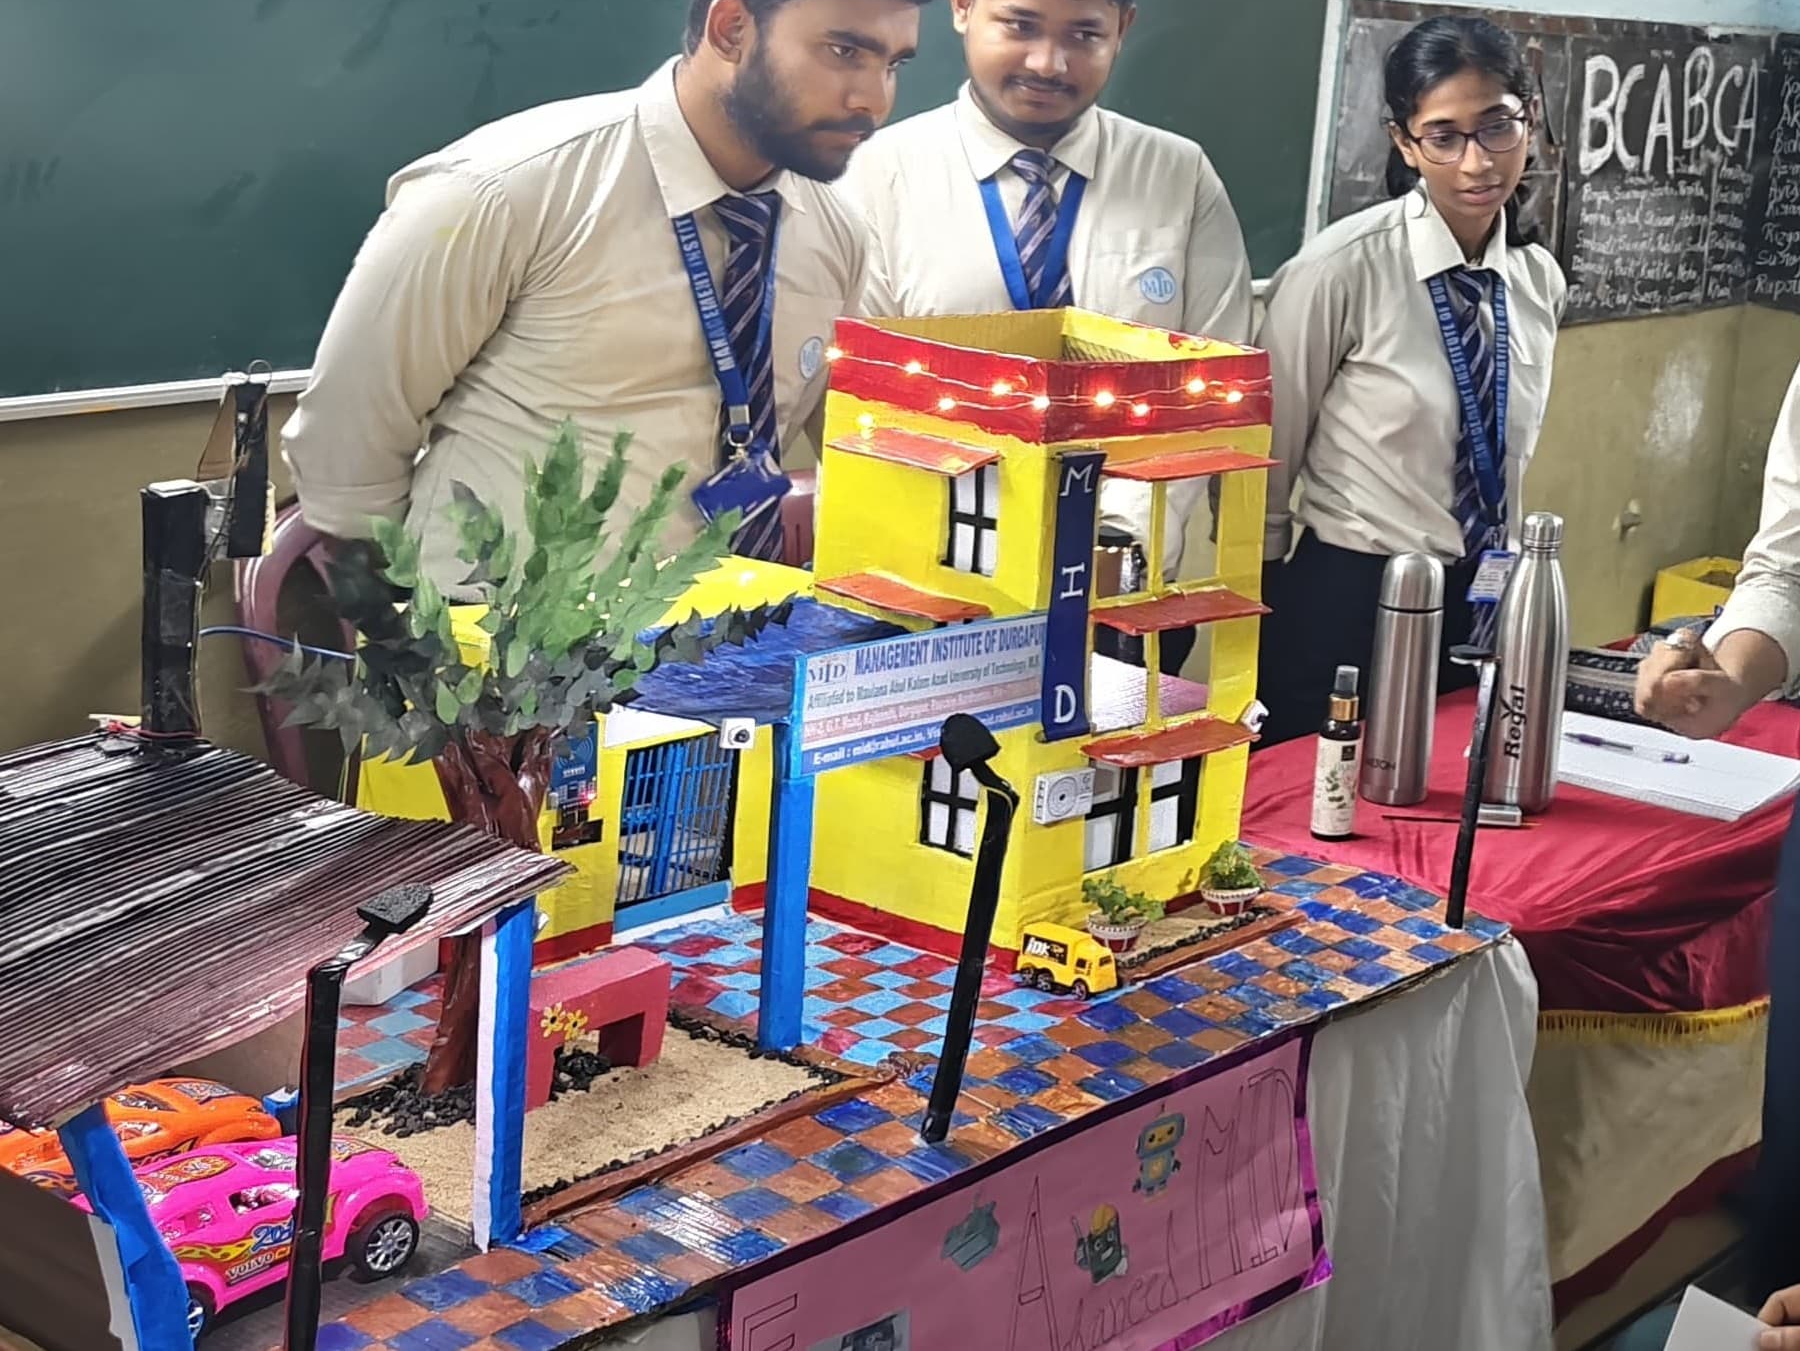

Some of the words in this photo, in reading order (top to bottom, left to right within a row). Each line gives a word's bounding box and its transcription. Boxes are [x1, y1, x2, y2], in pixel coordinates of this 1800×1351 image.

[1579, 53, 1676, 177] BCA
[1682, 46, 1758, 169] BCA
[675, 218, 705, 268] INSTIT
[854, 638, 931, 676] MANAGEMENT
[931, 631, 983, 663] INSTITUTE
[984, 628, 997, 654] OF
[1501, 684, 1528, 760] Regal
[226, 1253, 275, 1279] VOLVO
